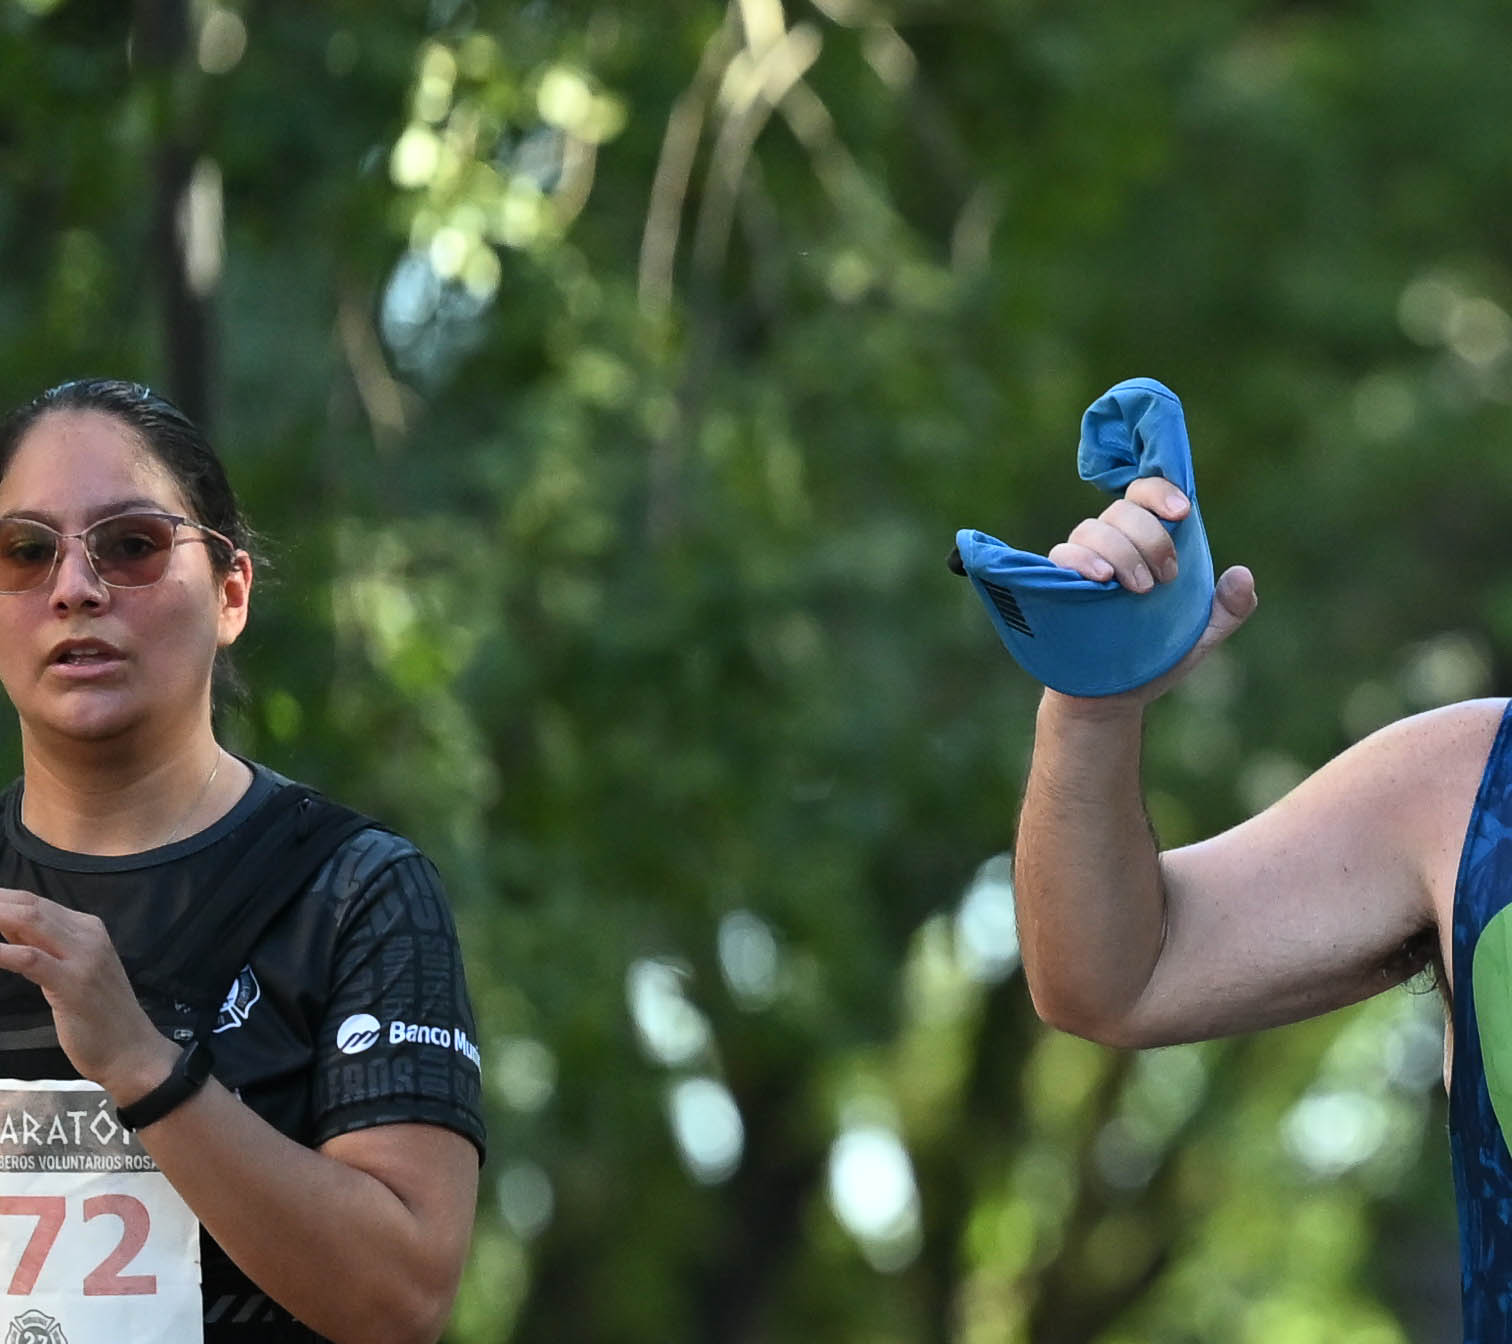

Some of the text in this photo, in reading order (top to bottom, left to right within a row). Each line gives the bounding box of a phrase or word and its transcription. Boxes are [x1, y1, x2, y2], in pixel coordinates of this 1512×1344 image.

[389, 1020, 451, 1049] Banco
[38, 1155, 122, 1171] VOLUNTARIOS
[0, 1193, 157, 1297] 72
